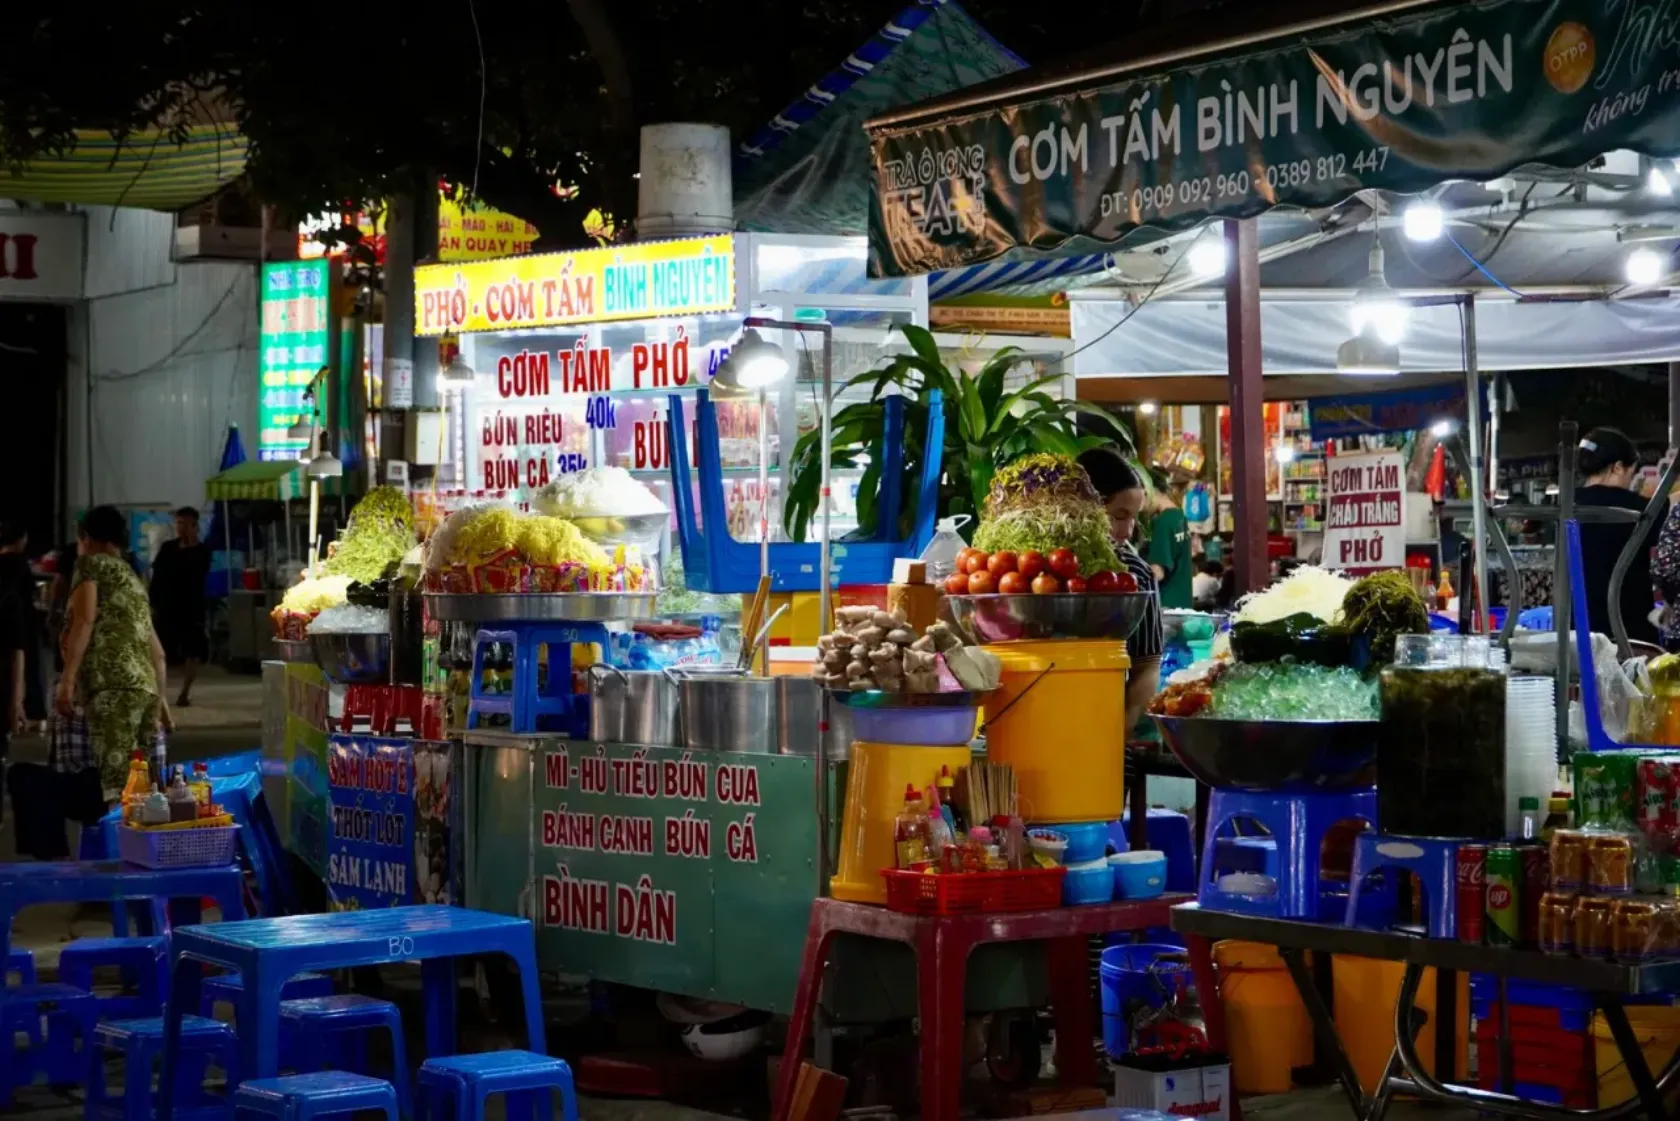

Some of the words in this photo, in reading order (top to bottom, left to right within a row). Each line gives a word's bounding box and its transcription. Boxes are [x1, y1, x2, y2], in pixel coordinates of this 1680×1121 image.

[1008, 122, 1088, 185] CƠM
[1102, 91, 1180, 167] TẤM
[1198, 79, 1298, 152] BÌNH
[1316, 28, 1513, 129] NGUYÊN
[1583, 84, 1650, 134] không
[937, 144, 985, 181] LONG
[1100, 193, 1128, 218] ĐT:
[1133, 183, 1174, 212] 0909
[1180, 177, 1212, 204] 092
[1217, 172, 1249, 199] 960
[1267, 163, 1311, 190] 0389
[1316, 155, 1347, 181] 812
[1352, 147, 1390, 175] 447
[466, 237, 506, 253] QUAY
[423, 271, 467, 328] PHỞ
[486, 276, 535, 323] CƠM
[542, 259, 595, 319] TẤM
[604, 260, 648, 312] BÌNH
[653, 245, 728, 308] NGUYÊN
[498, 348, 549, 398] CƠM
[559, 333, 611, 394] TẤM
[633, 325, 689, 389] PHỞ
[482, 410, 518, 447] BÚN
[525, 406, 563, 444] RIÊU
[585, 396, 617, 429] 40k
[483, 452, 519, 490] BÚN
[527, 450, 549, 488] CÁ
[1331, 464, 1362, 493] CƠM
[1366, 456, 1399, 491] TẤM
[1340, 530, 1384, 564] PHỞ
[612, 749, 658, 798] TIẾU
[663, 750, 707, 799] BÚN
[716, 764, 760, 806] CUA
[542, 801, 595, 850] BÁNH
[599, 817, 653, 856] CANH
[665, 808, 710, 858] BÚN
[726, 812, 757, 863] CÁ
[329, 846, 361, 888] SÂM
[364, 858, 406, 898] LẠNH
[543, 863, 609, 933] BÌNH
[615, 874, 677, 945] DÂN
